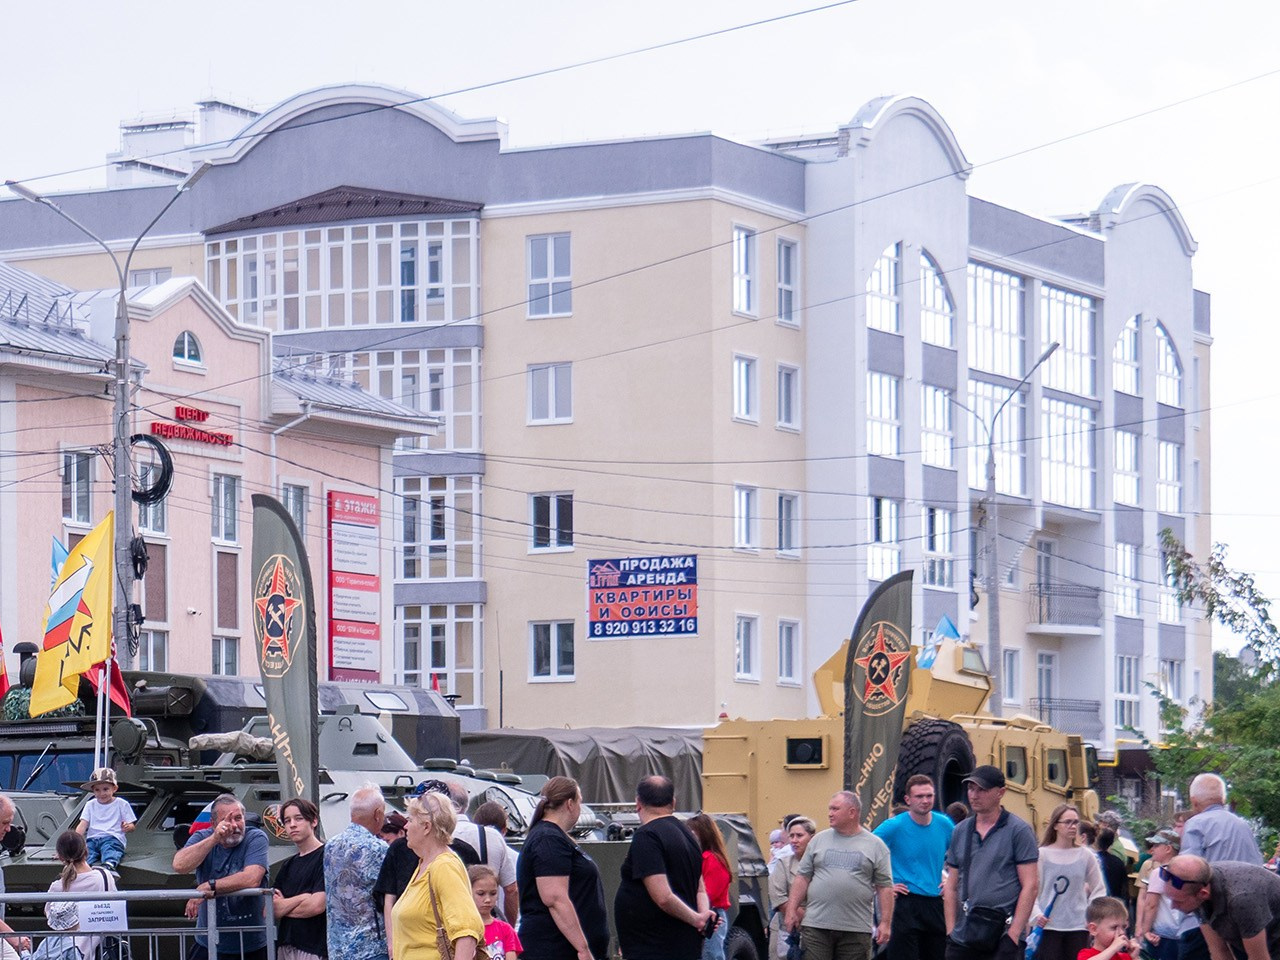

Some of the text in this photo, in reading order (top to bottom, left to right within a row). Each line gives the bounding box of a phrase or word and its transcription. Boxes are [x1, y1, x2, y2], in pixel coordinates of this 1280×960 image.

[152, 423, 233, 446] НЕДВИЖИМОСТИ
[620, 557, 694, 571] ПРОДАЖА
[626, 572, 687, 585] АРЕНДА
[595, 589, 692, 604] КВАРТИРЫ
[600, 605, 688, 619] И ОФИСЫ
[594, 619, 695, 635] 8 920 913 32 16
